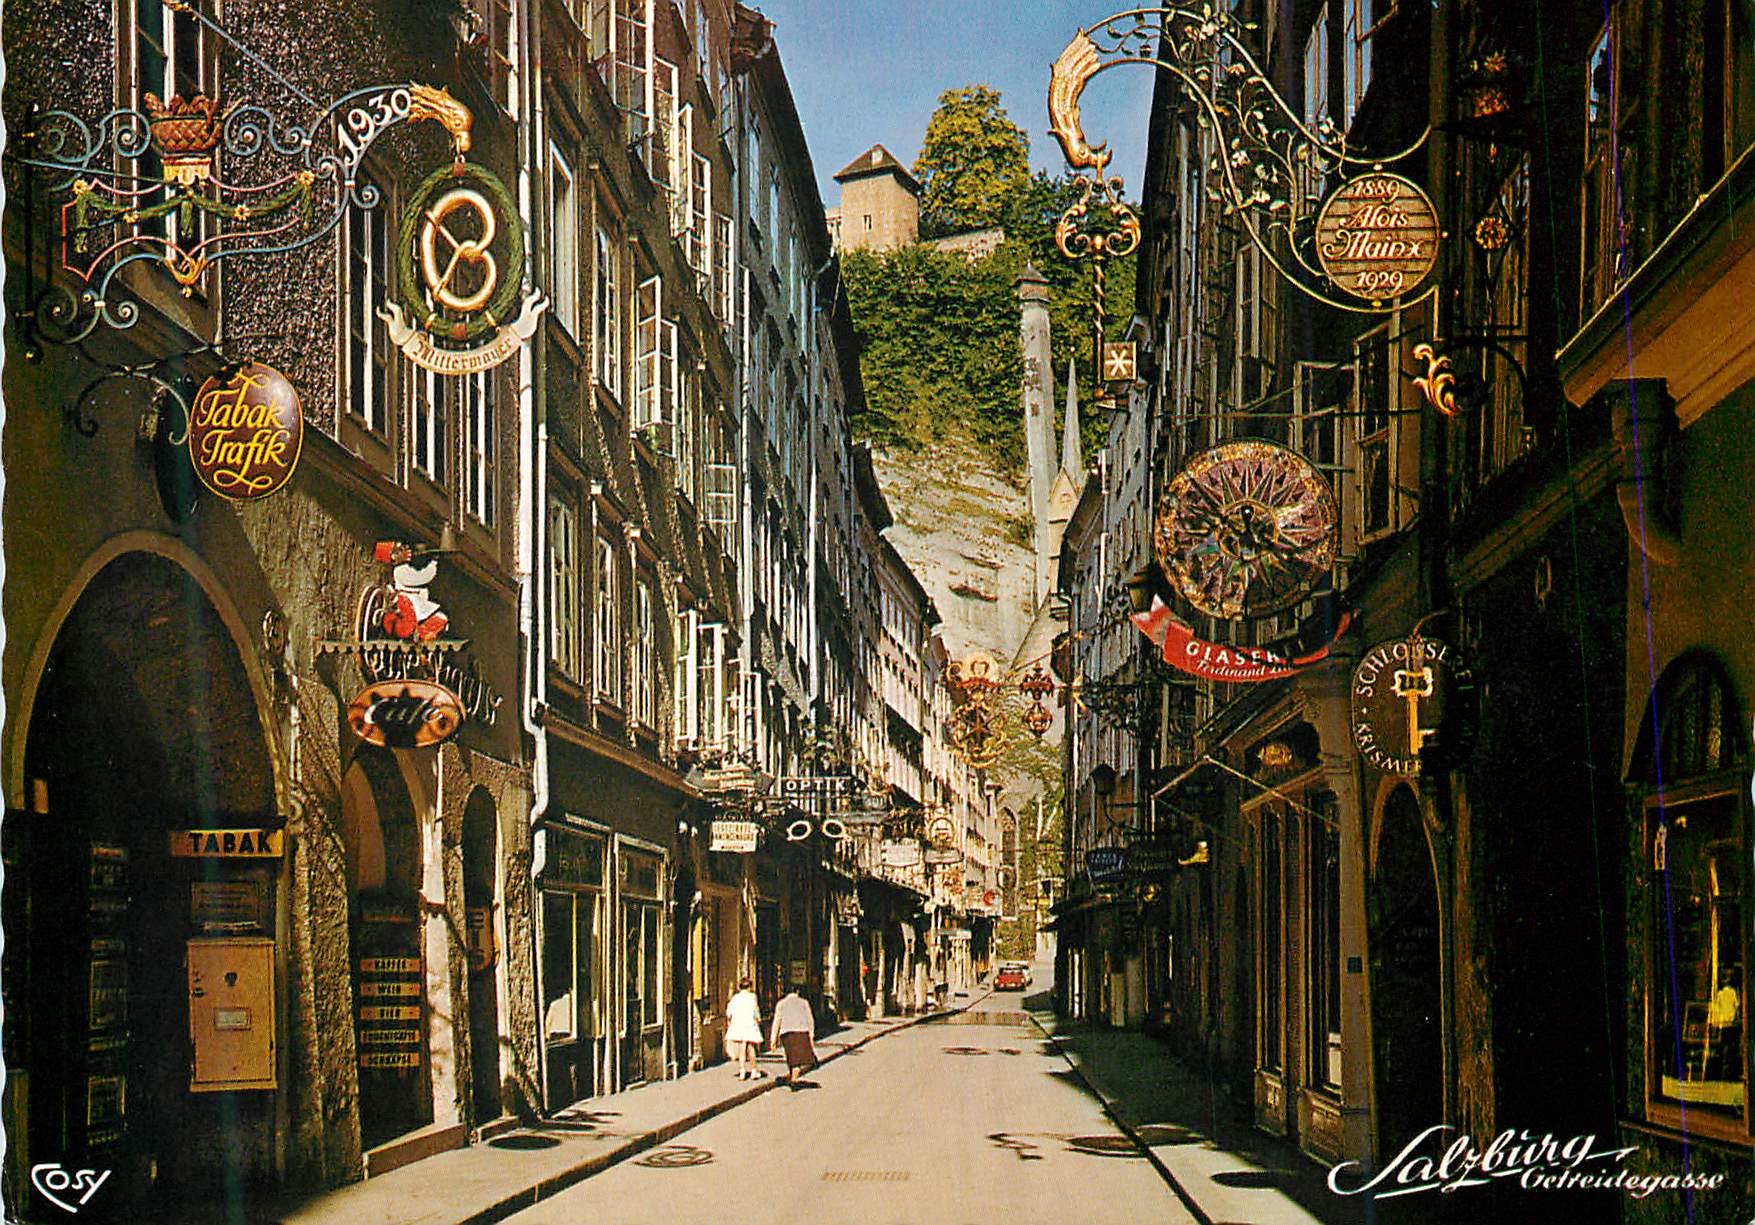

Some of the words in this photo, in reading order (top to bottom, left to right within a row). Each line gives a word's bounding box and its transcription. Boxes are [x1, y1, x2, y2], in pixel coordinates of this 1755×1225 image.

[337, 88, 411, 167] 1930
[1352, 179, 1401, 204] 1889
[1339, 202, 1409, 229] Alois
[1357, 270, 1404, 297] 1929
[196, 368, 286, 429] Tabak
[200, 428, 291, 495] Trafik
[785, 779, 847, 792] OPTIK
[188, 831, 272, 854] TABAK
